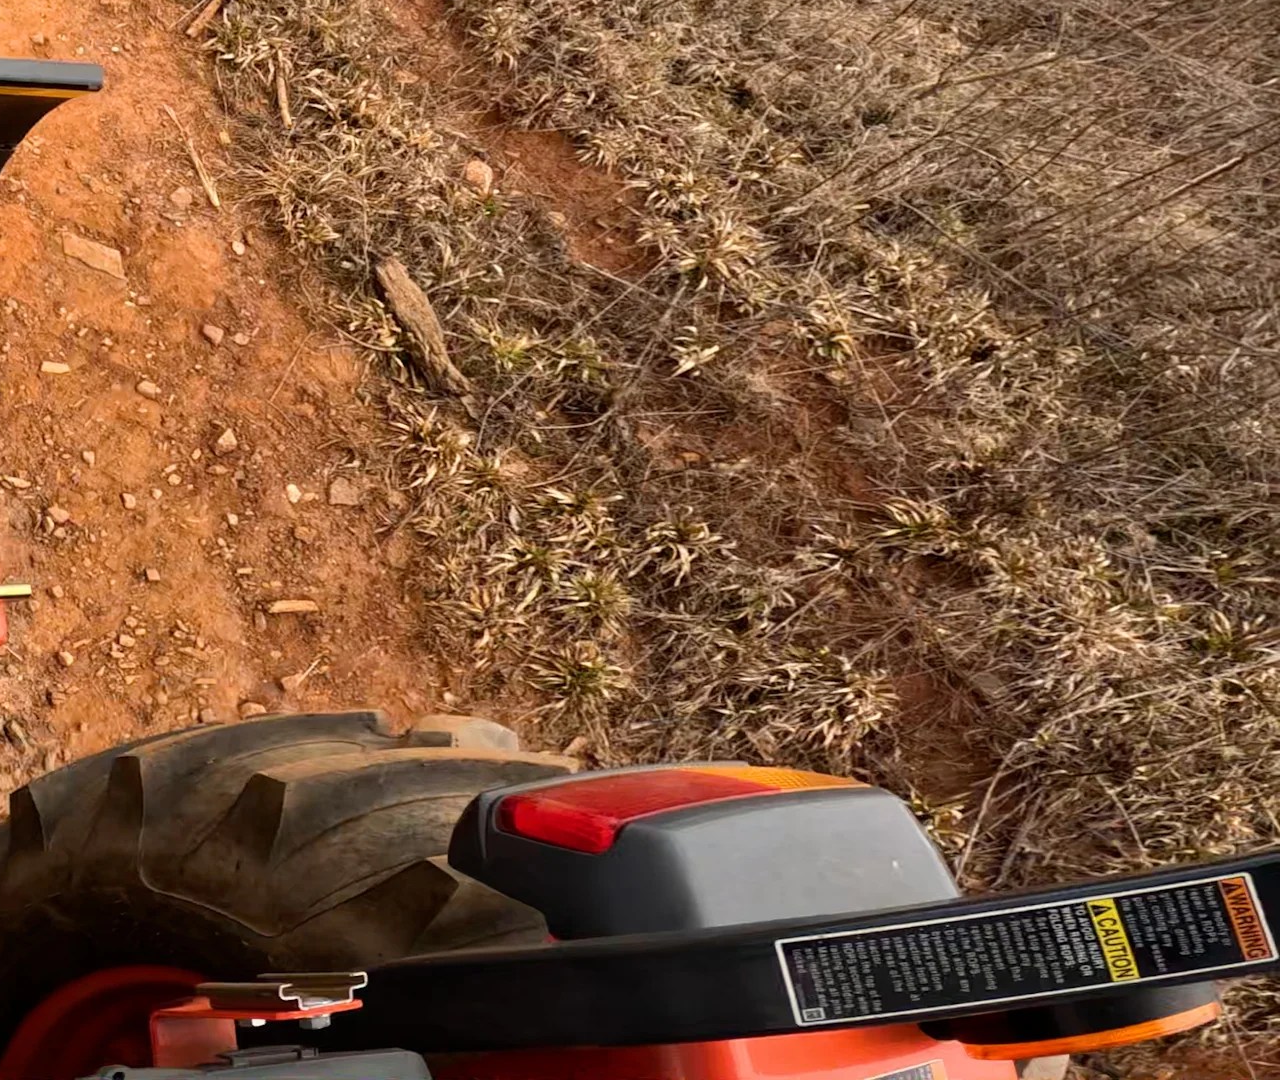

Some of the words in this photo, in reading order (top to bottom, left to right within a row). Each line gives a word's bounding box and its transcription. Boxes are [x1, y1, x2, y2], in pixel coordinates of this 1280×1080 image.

[1148, 904, 1168, 931] cutting
[1174, 889, 1194, 922] because
[1187, 888, 1205, 911] repair
[1200, 919, 1218, 943] ROPS
[1211, 910, 1230, 936] modify
[1226, 892, 1268, 959] WARNING
[1046, 908, 1068, 943] FOLDING
[1058, 943, 1077, 968] ROPS:
[1059, 906, 1077, 930] WHEN
[1068, 931, 1089, 963] RAISING
[1077, 916, 1095, 941] AVOID
[1086, 941, 1105, 970] INJURY
[1096, 916, 1135, 978] CAUTION
[1132, 896, 1150, 924] portion
[1149, 943, 1168, 972] weaken
